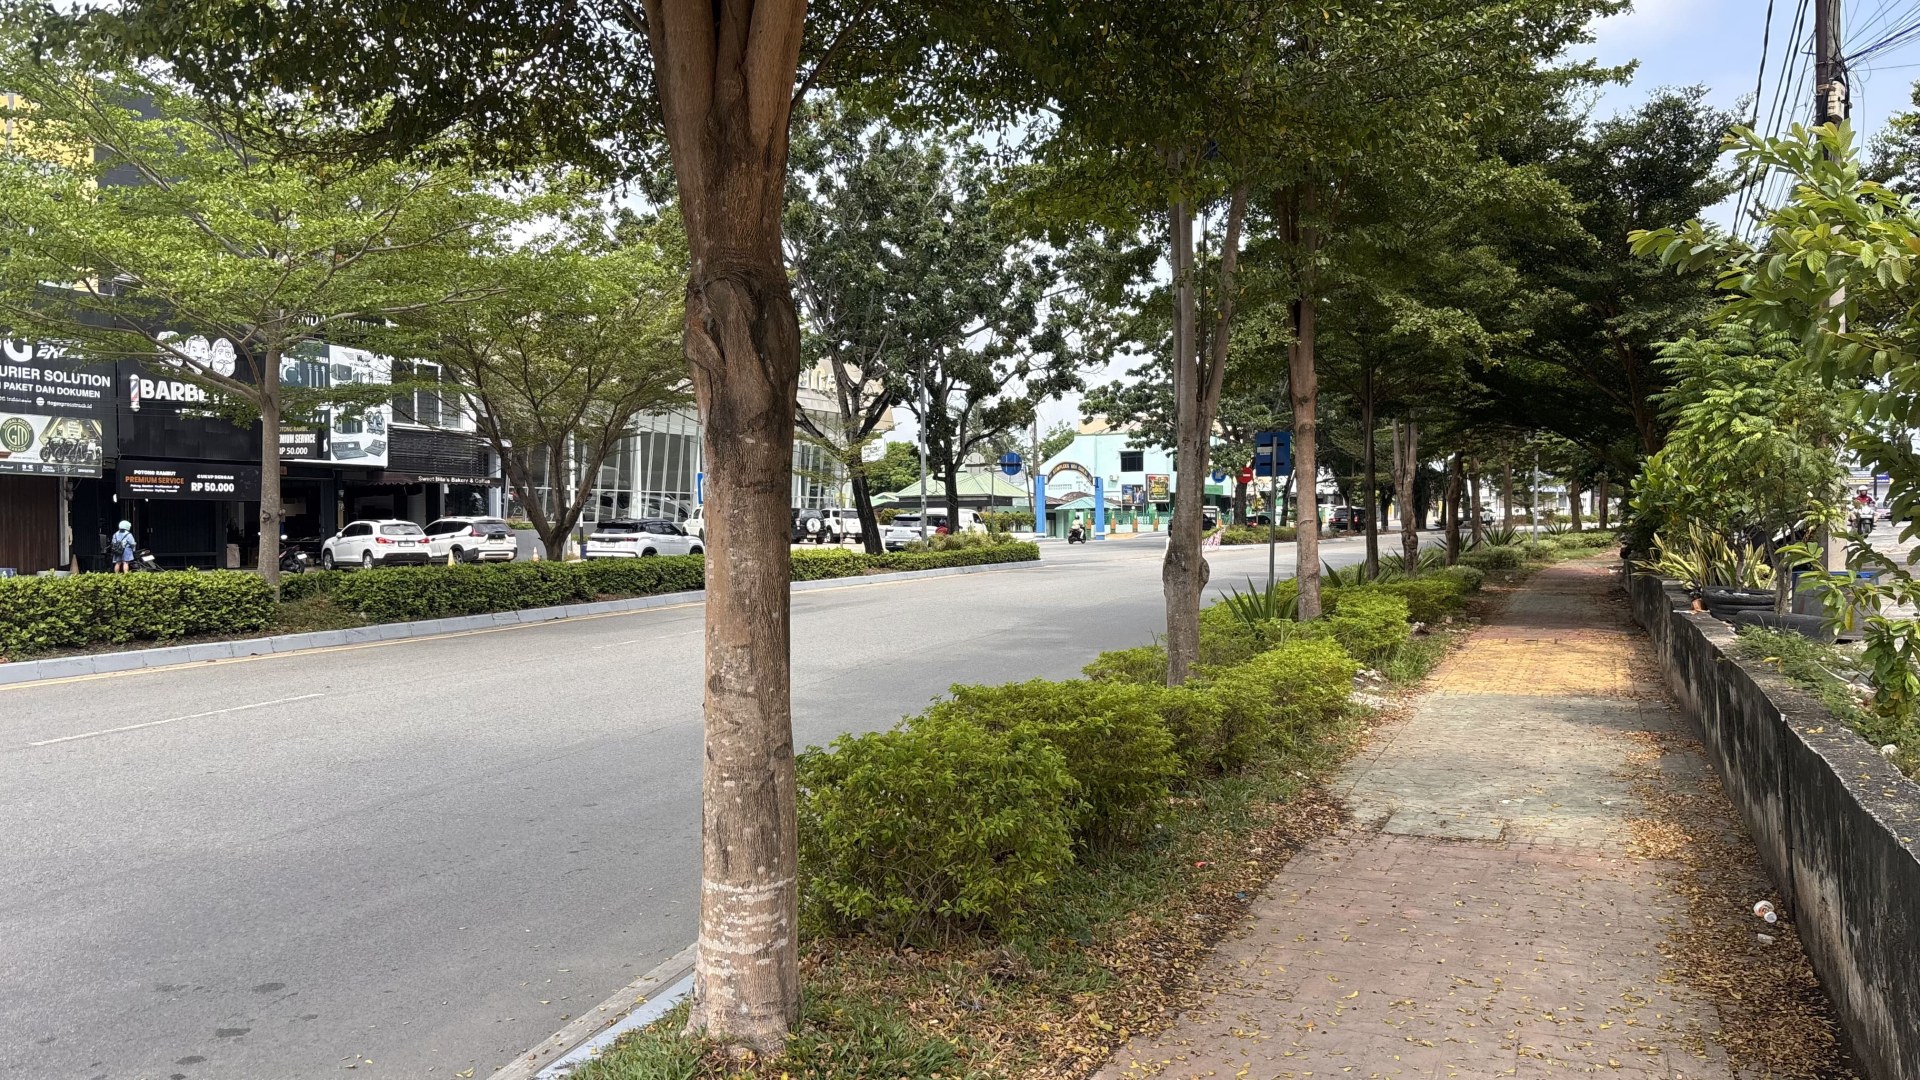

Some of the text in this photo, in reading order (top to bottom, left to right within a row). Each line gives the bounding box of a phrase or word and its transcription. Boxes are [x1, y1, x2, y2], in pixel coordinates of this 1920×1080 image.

[44, 369, 110, 387] SOLUTION
[3, 382, 101, 398] PAKET DAN DOKUMEN
[295, 434, 316, 443] SERVICE
[286, 446, 308, 455] 50.000
[125, 476, 185, 485] PREMIUM SERVICE
[191, 482, 203, 492] RP
[204, 482, 235, 492] 50.000
